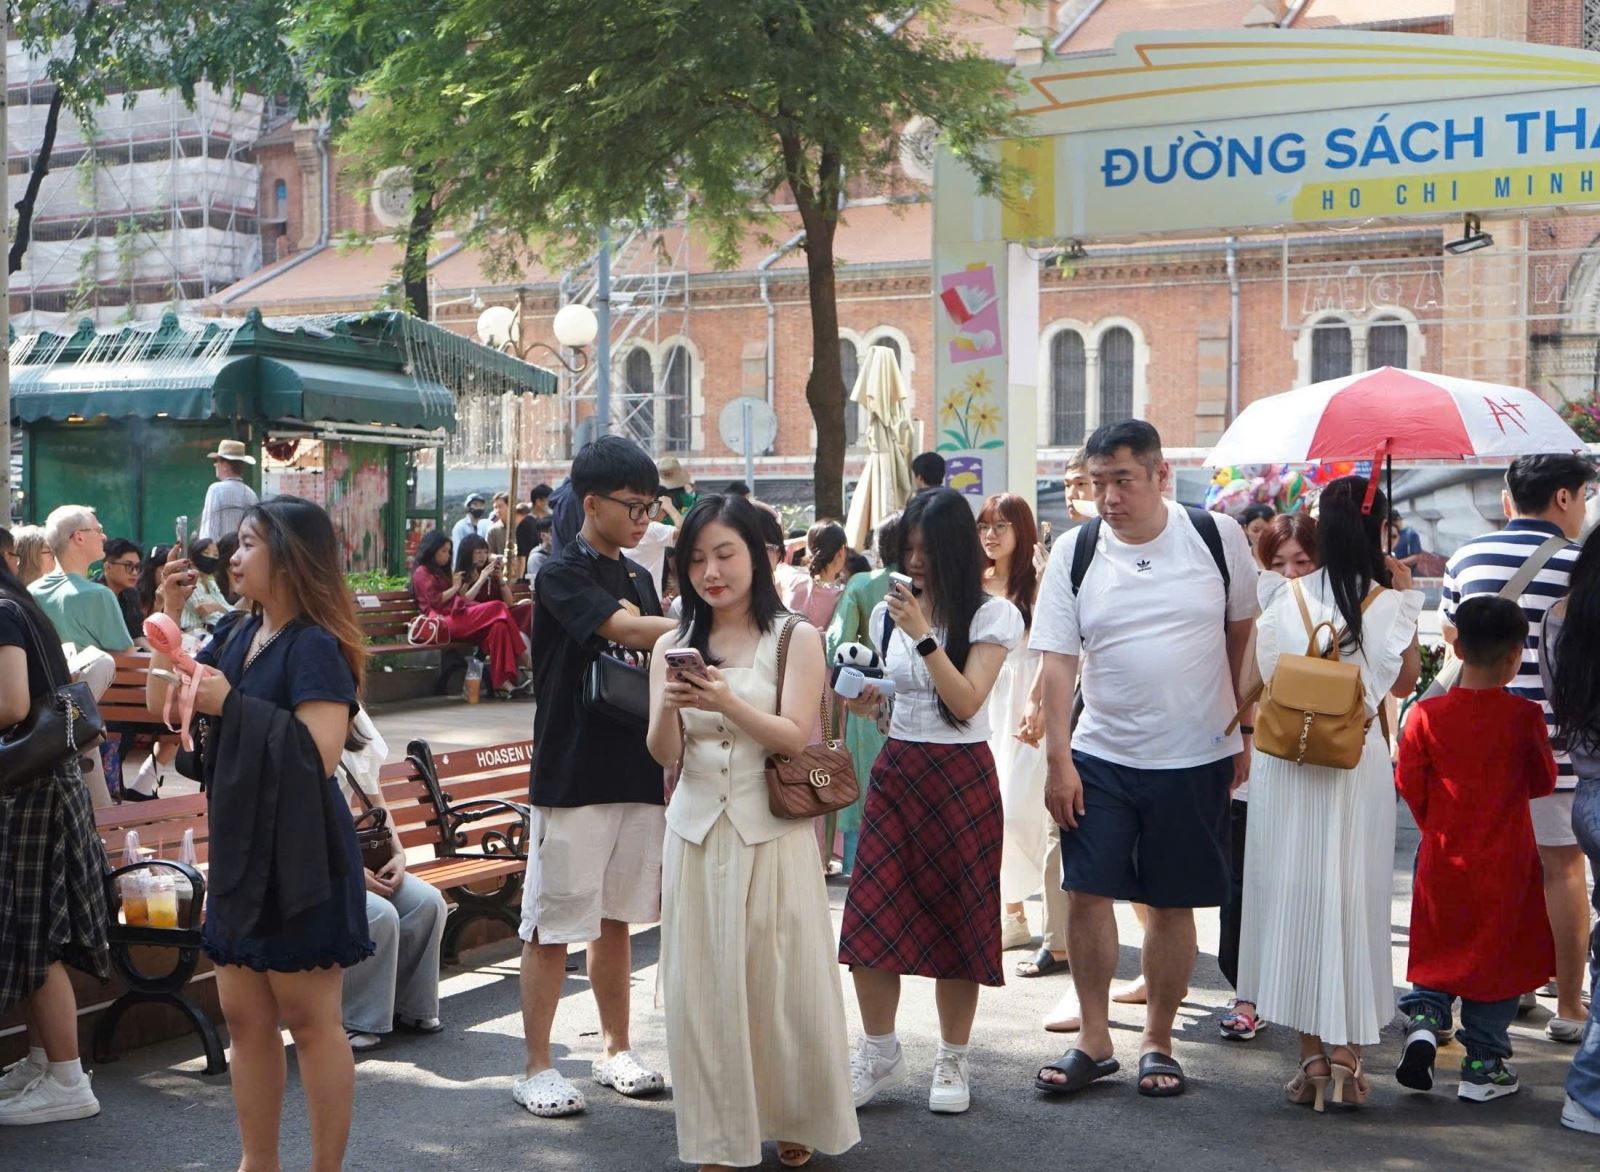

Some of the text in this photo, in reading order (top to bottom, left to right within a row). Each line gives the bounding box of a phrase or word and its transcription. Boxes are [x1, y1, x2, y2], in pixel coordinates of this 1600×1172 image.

[1101, 107, 1600, 187] ĐƯỜNG SÁCH TH
[1322, 170, 1593, 210] HO CHI MINH
[1483, 396, 1529, 436] A+
[476, 745, 524, 768] HOASEN
